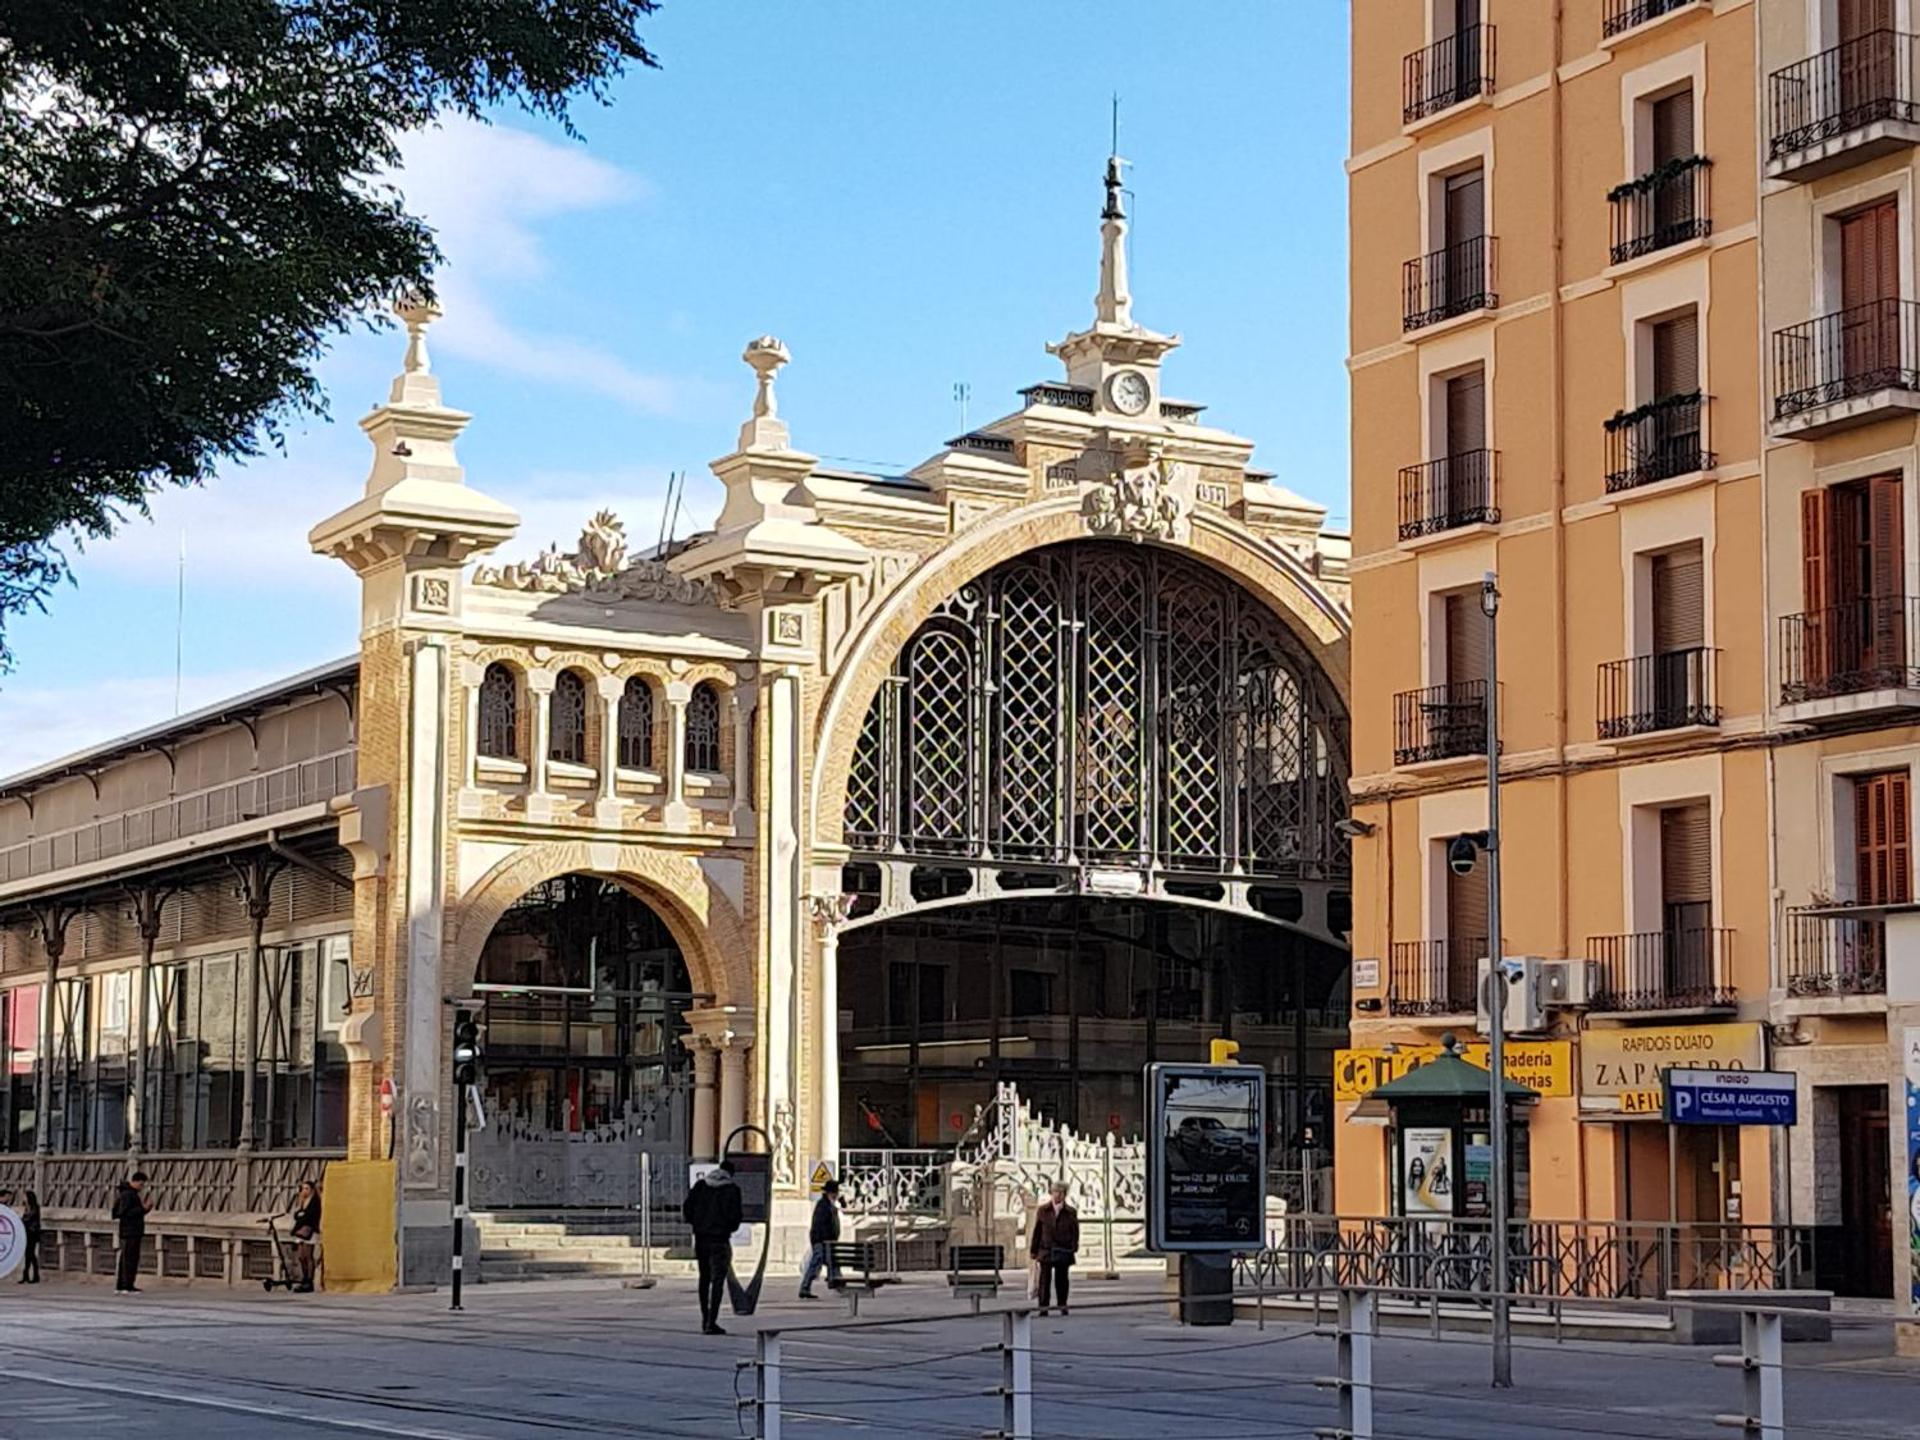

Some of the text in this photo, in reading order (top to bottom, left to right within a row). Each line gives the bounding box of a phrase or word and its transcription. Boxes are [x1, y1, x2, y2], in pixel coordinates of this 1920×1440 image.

[1622, 1034, 1714, 1052] RAPIDOS DUATO
[1484, 1050, 1552, 1067] Pnadería
[1675, 1091, 1692, 1118] P
[1701, 1090, 1790, 1107] CÉSAR AUGUSTO
